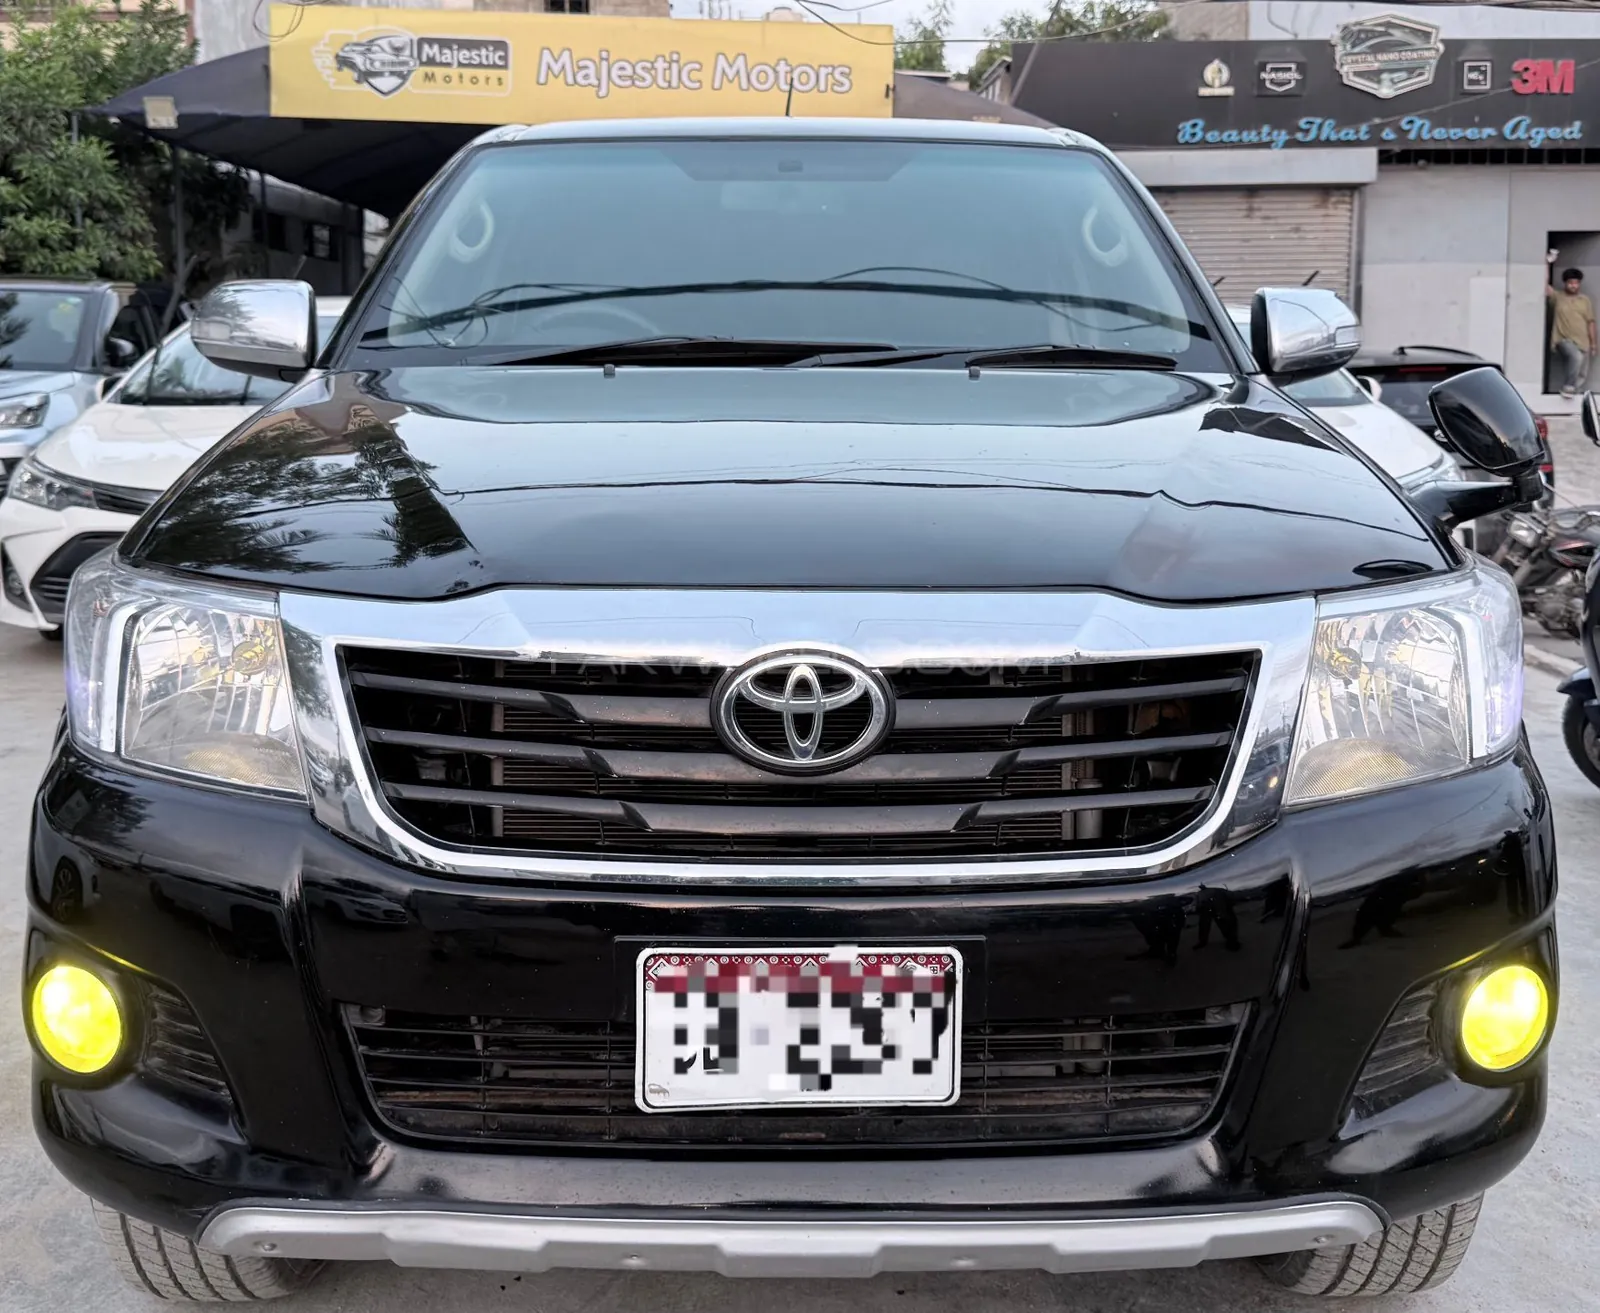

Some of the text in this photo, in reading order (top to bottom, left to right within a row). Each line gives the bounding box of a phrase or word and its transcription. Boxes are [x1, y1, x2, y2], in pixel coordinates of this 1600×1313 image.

[421, 42, 506, 69] Majestic
[537, 47, 853, 99] Majestic Motors
[423, 71, 504, 87] Motors
[1511, 58, 1576, 95] 3M
[1177, 118, 1288, 150] Beauty
[1295, 117, 1371, 142] That
[1400, 116, 1498, 141] Never
[1502, 115, 1583, 149] Aged
